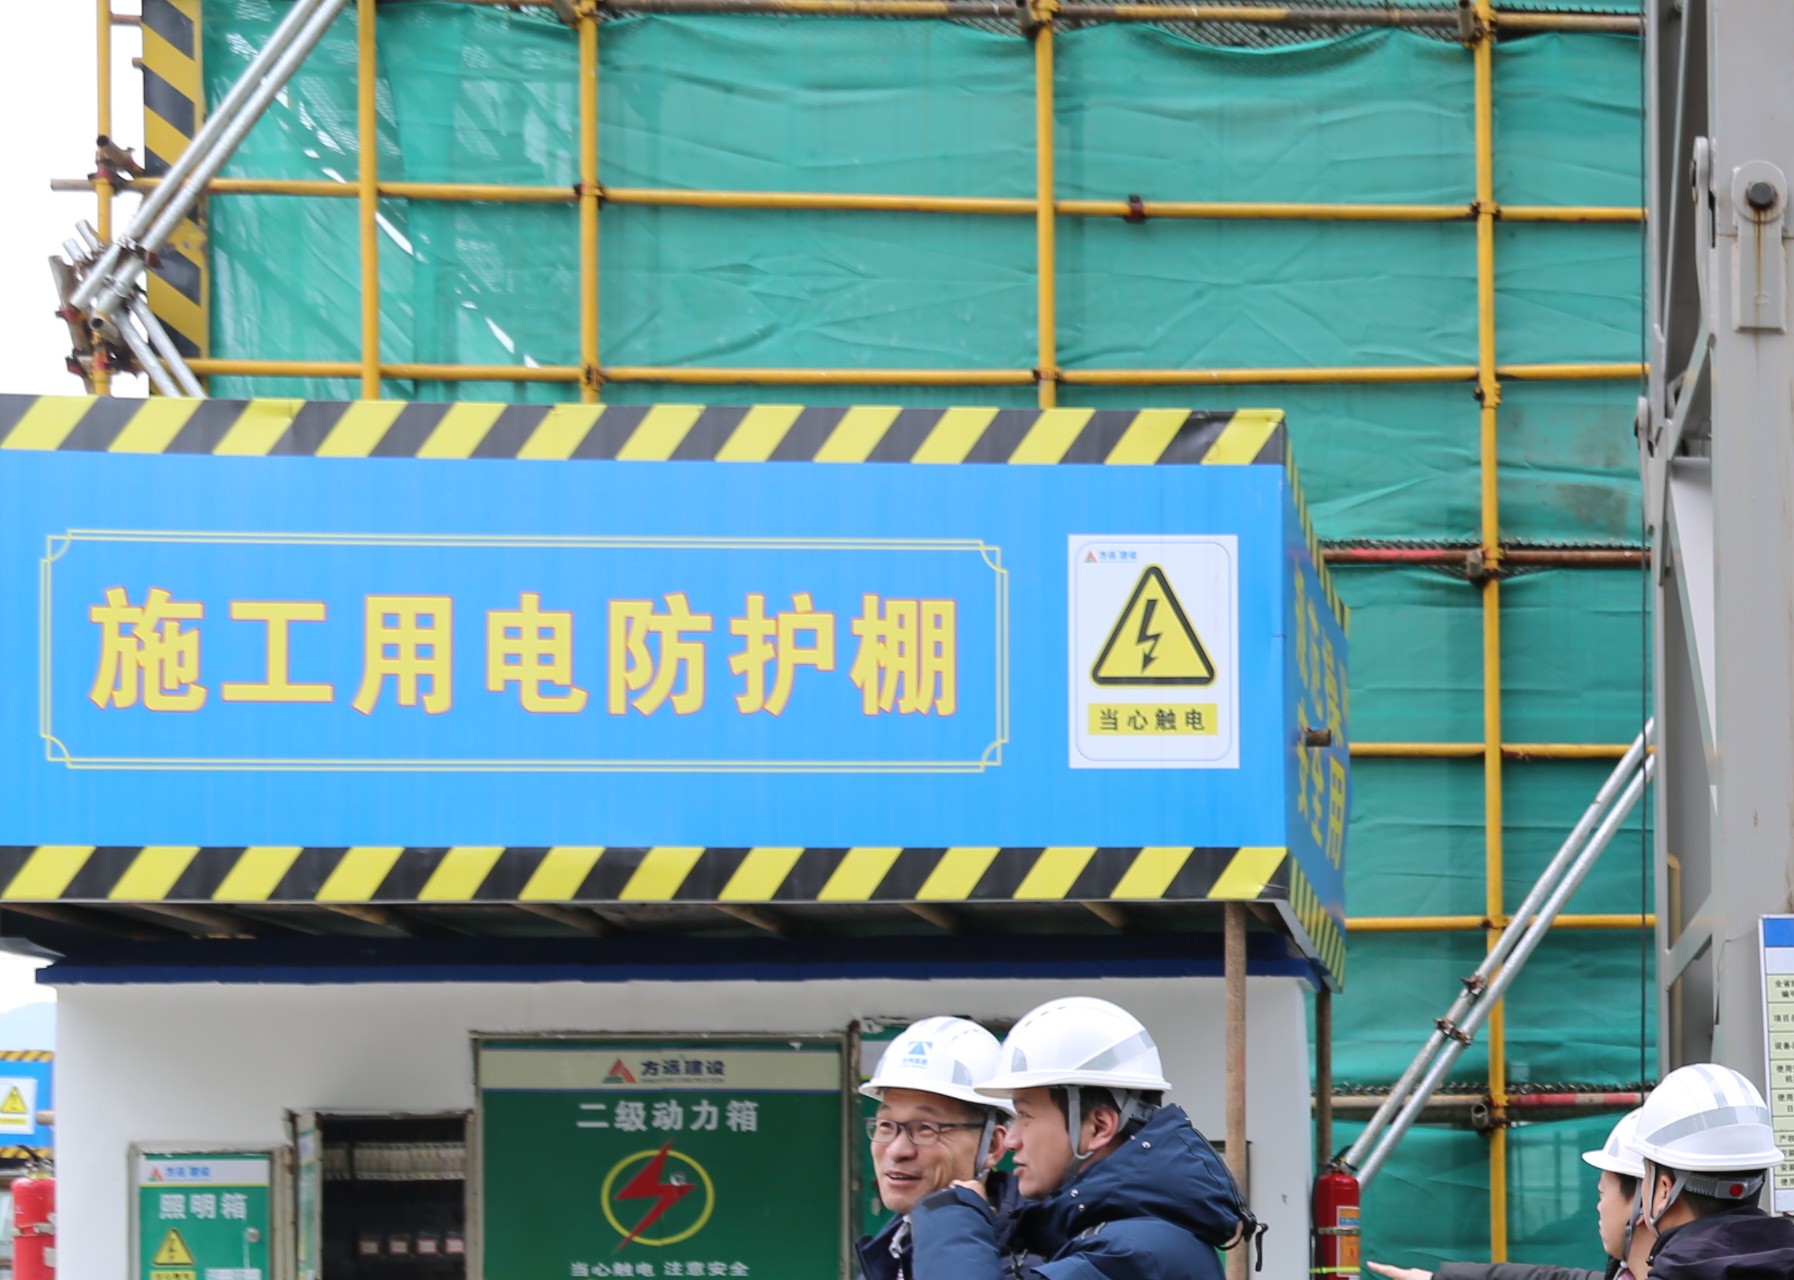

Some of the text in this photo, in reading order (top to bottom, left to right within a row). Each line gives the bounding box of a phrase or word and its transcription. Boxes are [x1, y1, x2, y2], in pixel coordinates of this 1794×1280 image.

[90, 587, 957, 716] 施工用电防护棚
[1100, 709, 1205, 731] 当心触电
[641, 1059, 726, 1077] 方远建设
[576, 1099, 759, 1132] 二级动力箱
[159, 1192, 248, 1220] 照明箱
[570, 1260, 750, 1277] 当心触电 注意安全
